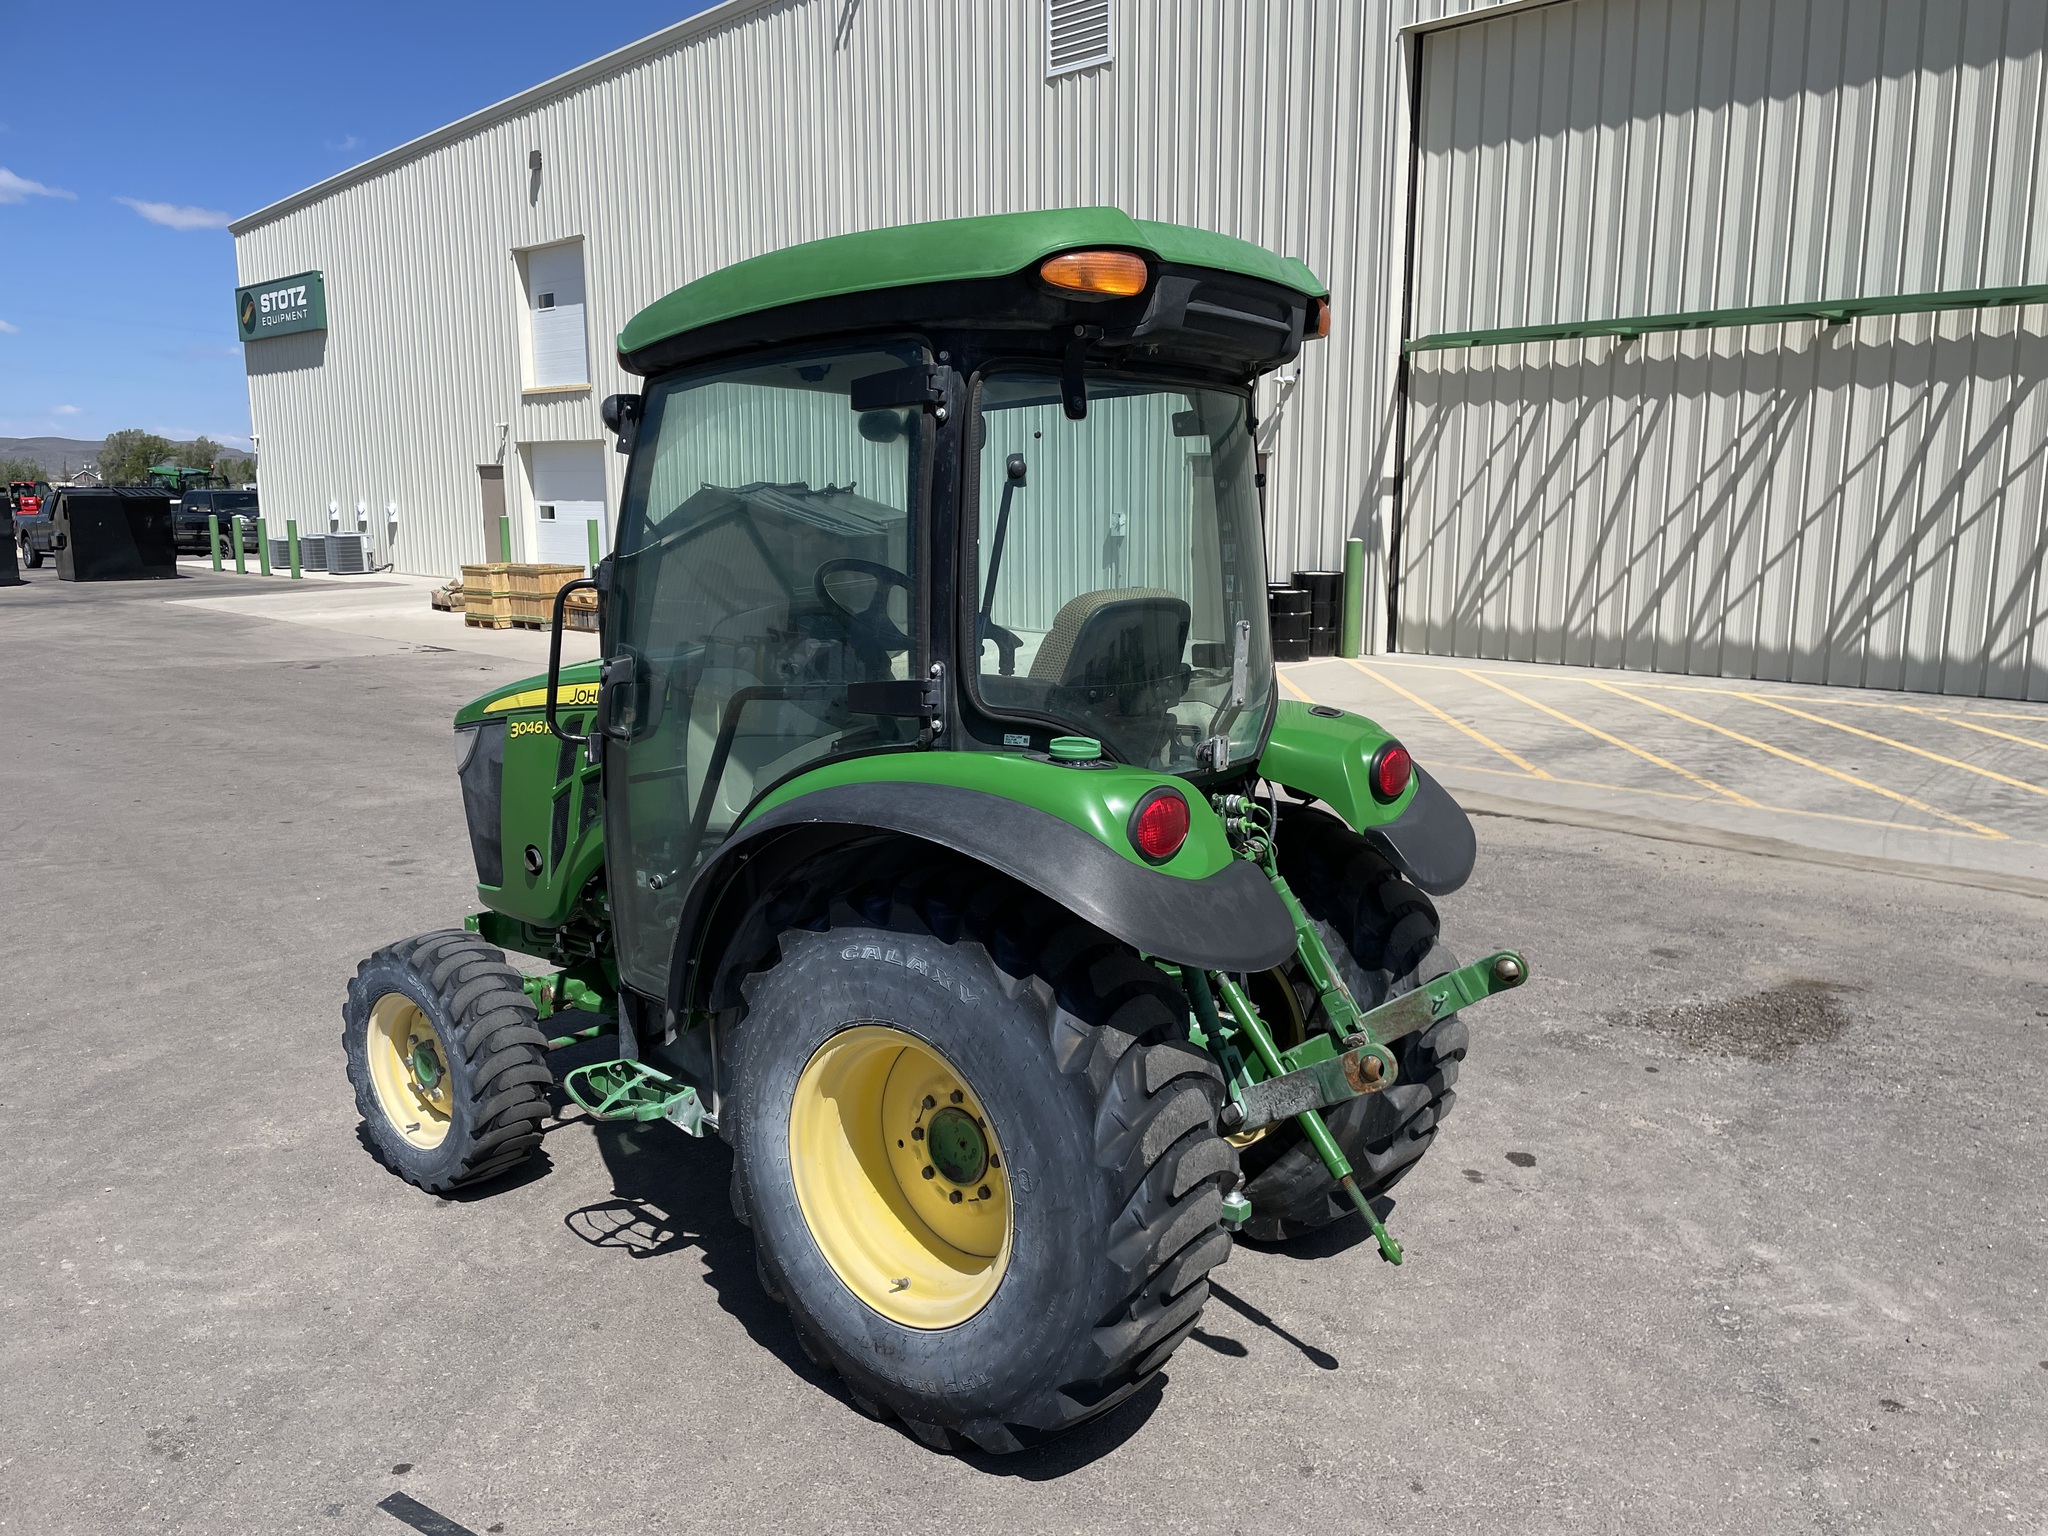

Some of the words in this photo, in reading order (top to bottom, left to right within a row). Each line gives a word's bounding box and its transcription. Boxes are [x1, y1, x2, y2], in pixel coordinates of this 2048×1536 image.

[260, 285, 307, 313] STOTZ
[262, 309, 308, 326] EQUIPMENT
[569, 687, 599, 704] JOH
[841, 944, 980, 1004] GALAXY
[406, 973, 462, 1060] GALAXY
